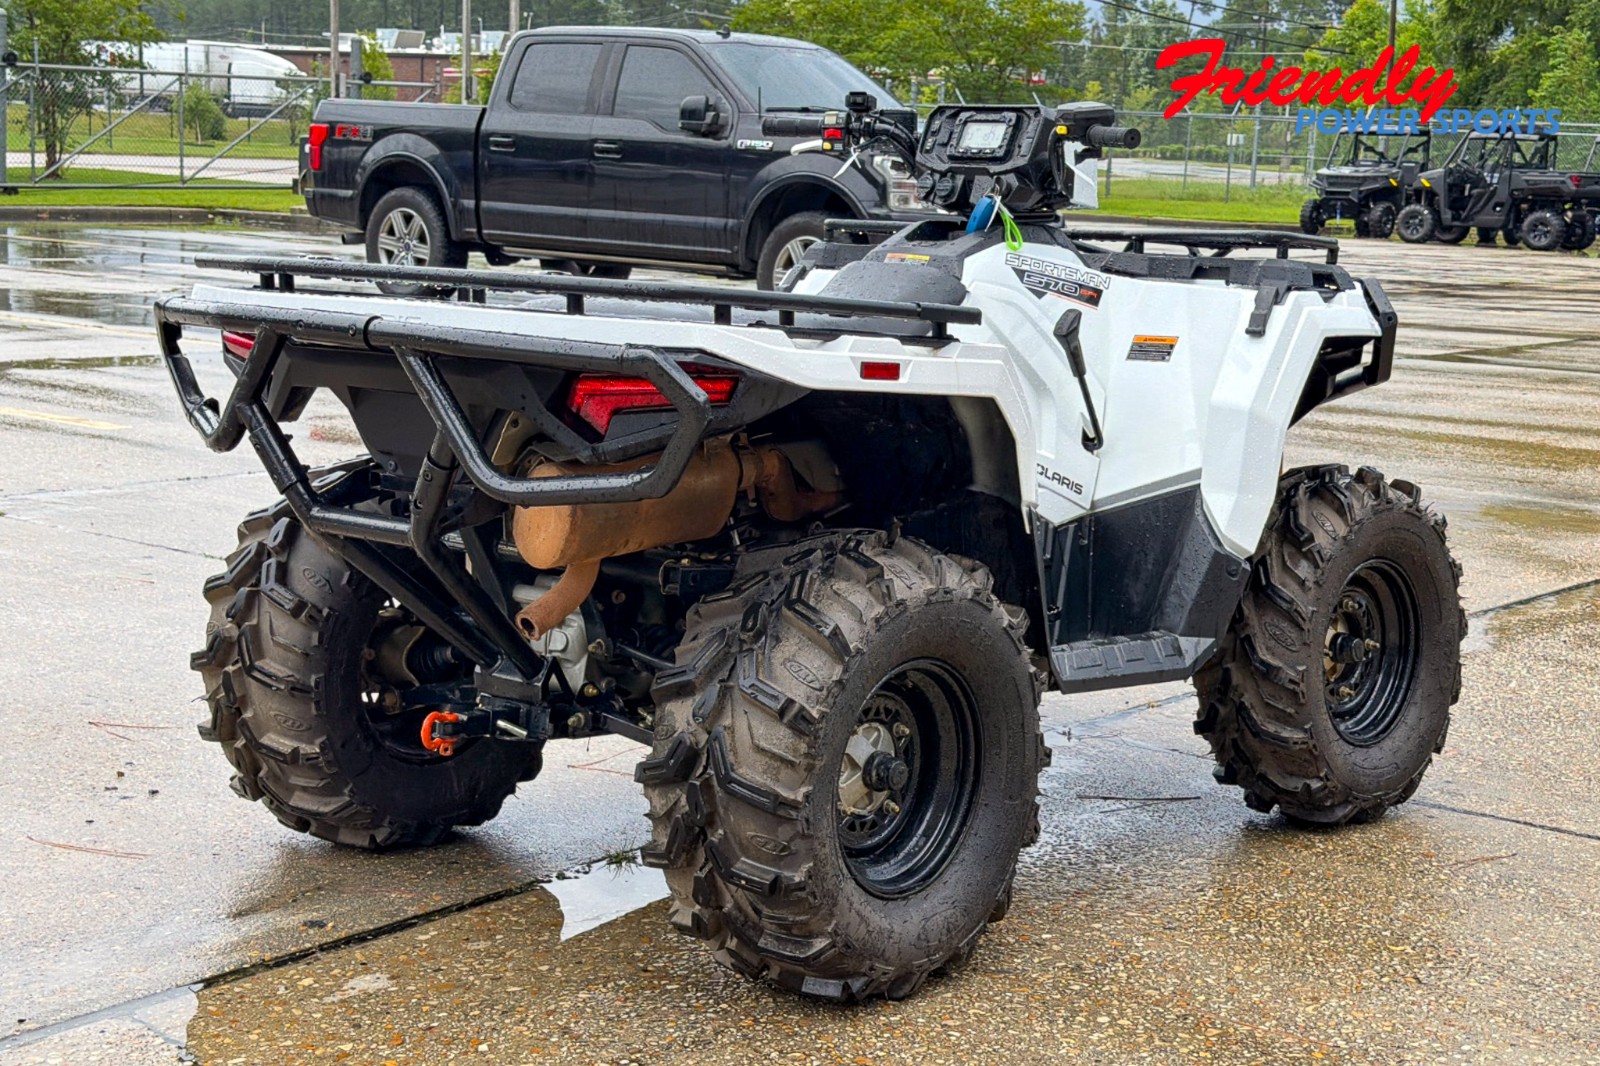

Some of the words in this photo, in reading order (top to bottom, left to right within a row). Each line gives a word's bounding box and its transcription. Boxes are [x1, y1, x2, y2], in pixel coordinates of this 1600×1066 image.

[1005, 252, 1111, 290] SPORTSMAN
[1023, 271, 1079, 297] 570
[1036, 462, 1083, 495] OLARIS
